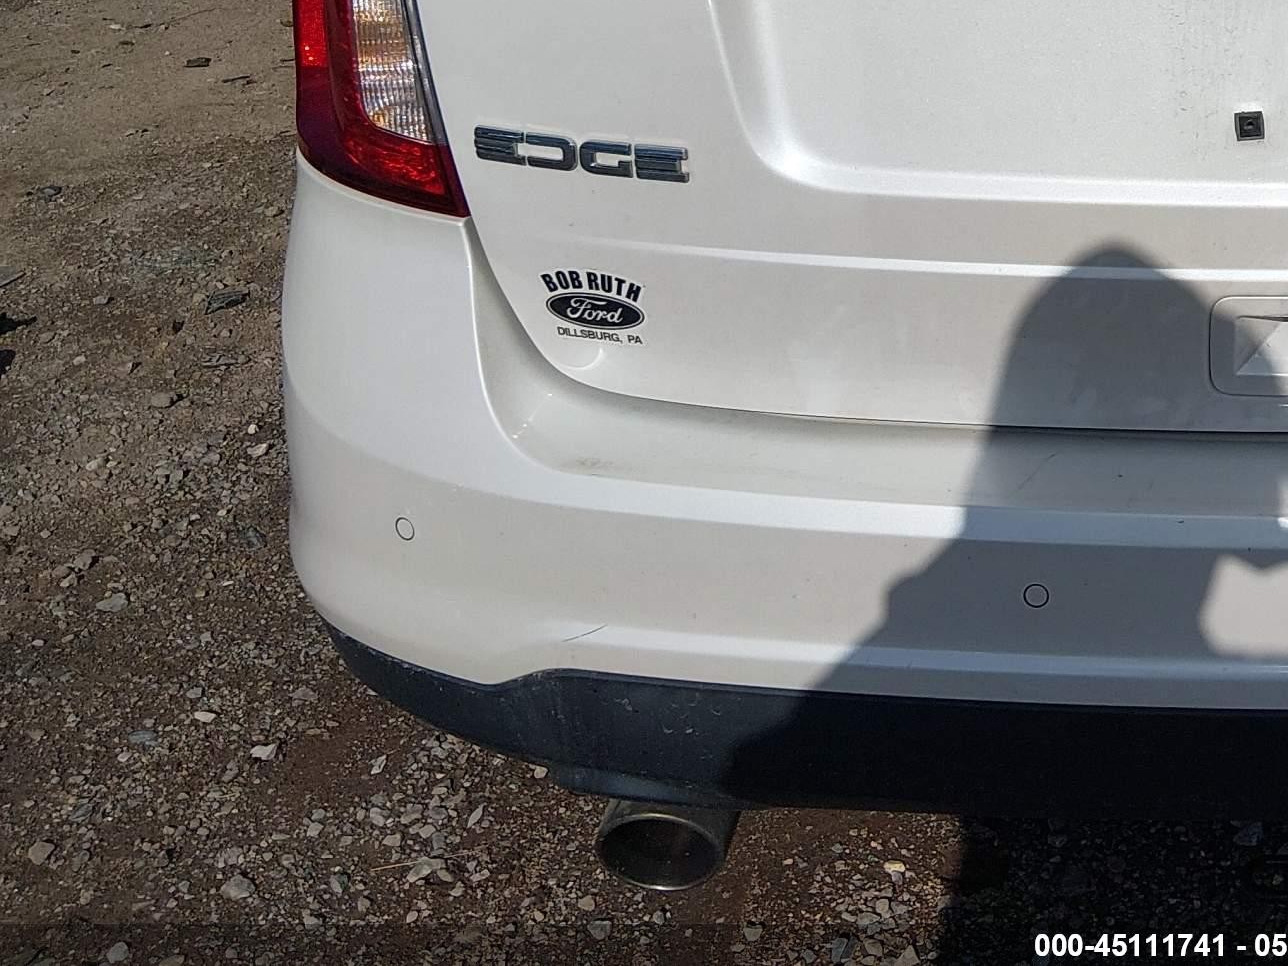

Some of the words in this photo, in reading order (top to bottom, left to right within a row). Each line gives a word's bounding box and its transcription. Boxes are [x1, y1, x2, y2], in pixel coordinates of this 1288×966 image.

[474, 125, 690, 183] EDGE
[540, 270, 583, 293] BOB
[586, 272, 642, 302] RUTH
[566, 297, 624, 324] Ford
[557, 327, 623, 344] DILLSBURG,
[627, 333, 643, 344] PA
